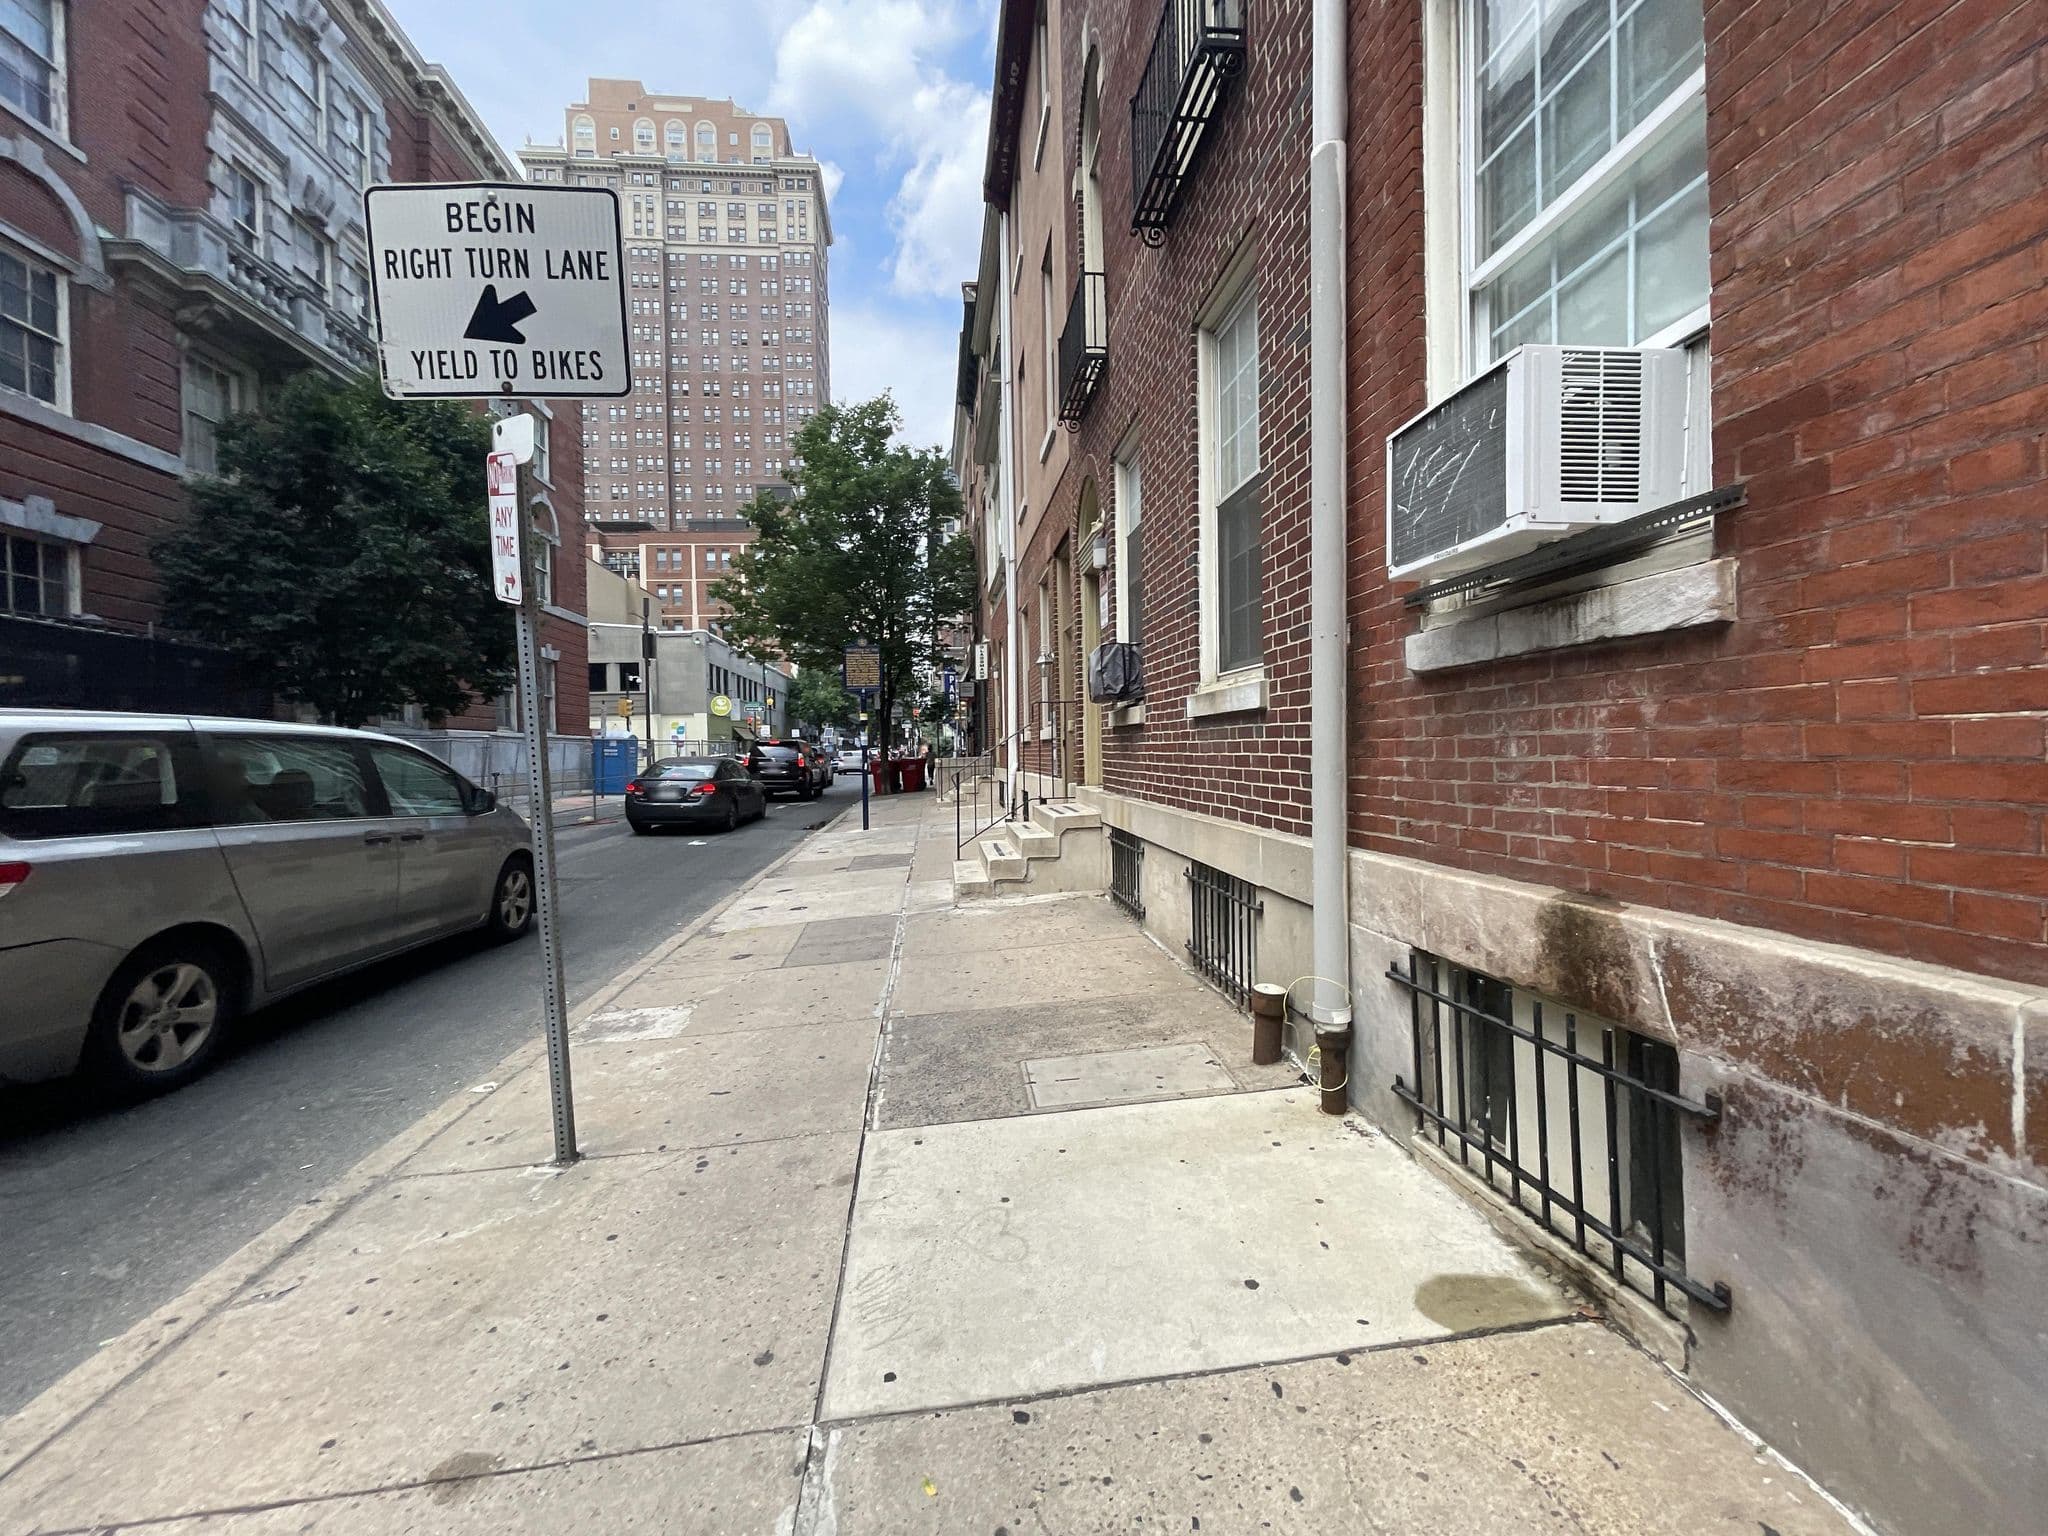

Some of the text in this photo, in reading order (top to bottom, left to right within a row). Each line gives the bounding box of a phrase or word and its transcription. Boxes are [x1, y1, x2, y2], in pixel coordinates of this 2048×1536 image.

[446, 201, 535, 234] BEGIN
[384, 248, 610, 281] RIGHT TURN LANE
[410, 349, 604, 380] YIELD TO BIKES
[495, 506, 513, 528] ANY
[495, 535, 515, 557] TIME
